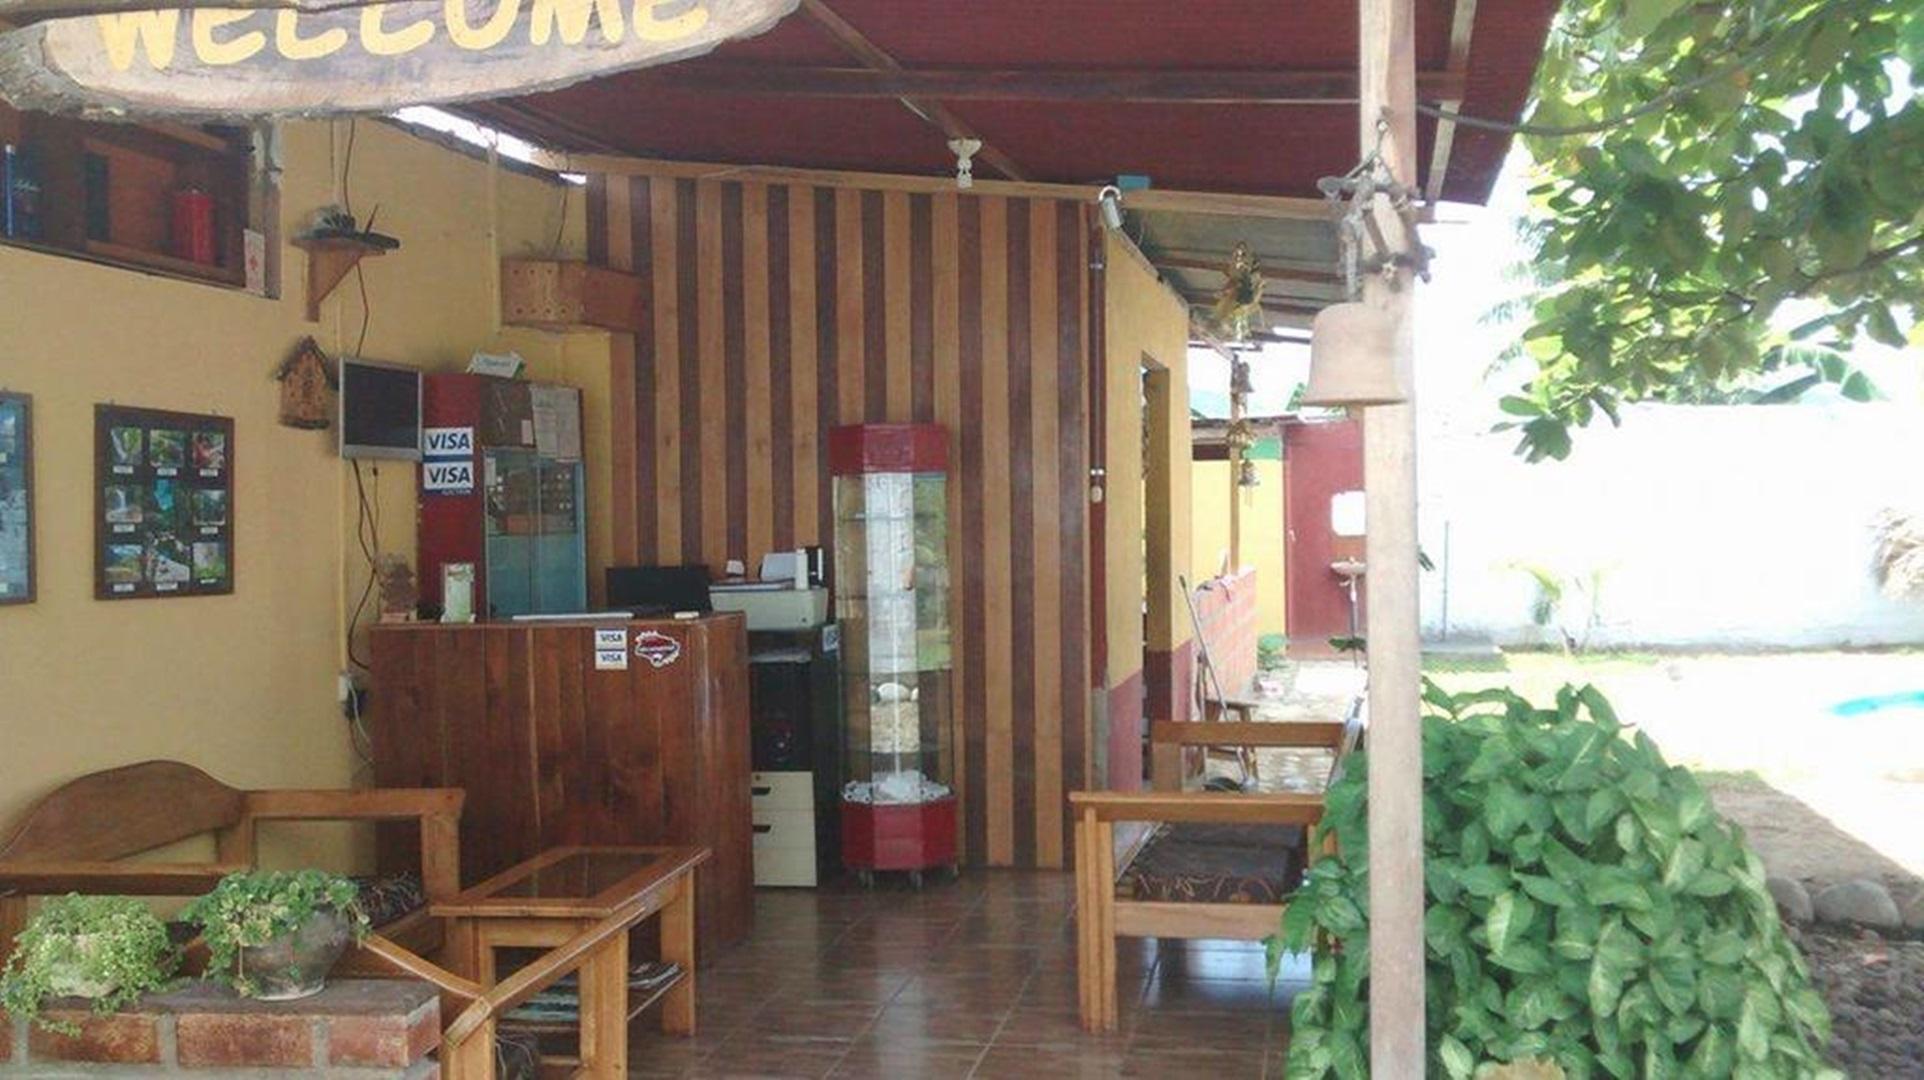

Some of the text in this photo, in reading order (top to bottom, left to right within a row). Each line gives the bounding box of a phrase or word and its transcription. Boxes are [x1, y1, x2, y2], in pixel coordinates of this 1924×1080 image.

[428, 433, 471, 449] VISA
[429, 467, 471, 483] VISA
[601, 633, 623, 642] VISA
[601, 653, 623, 662] VISA
